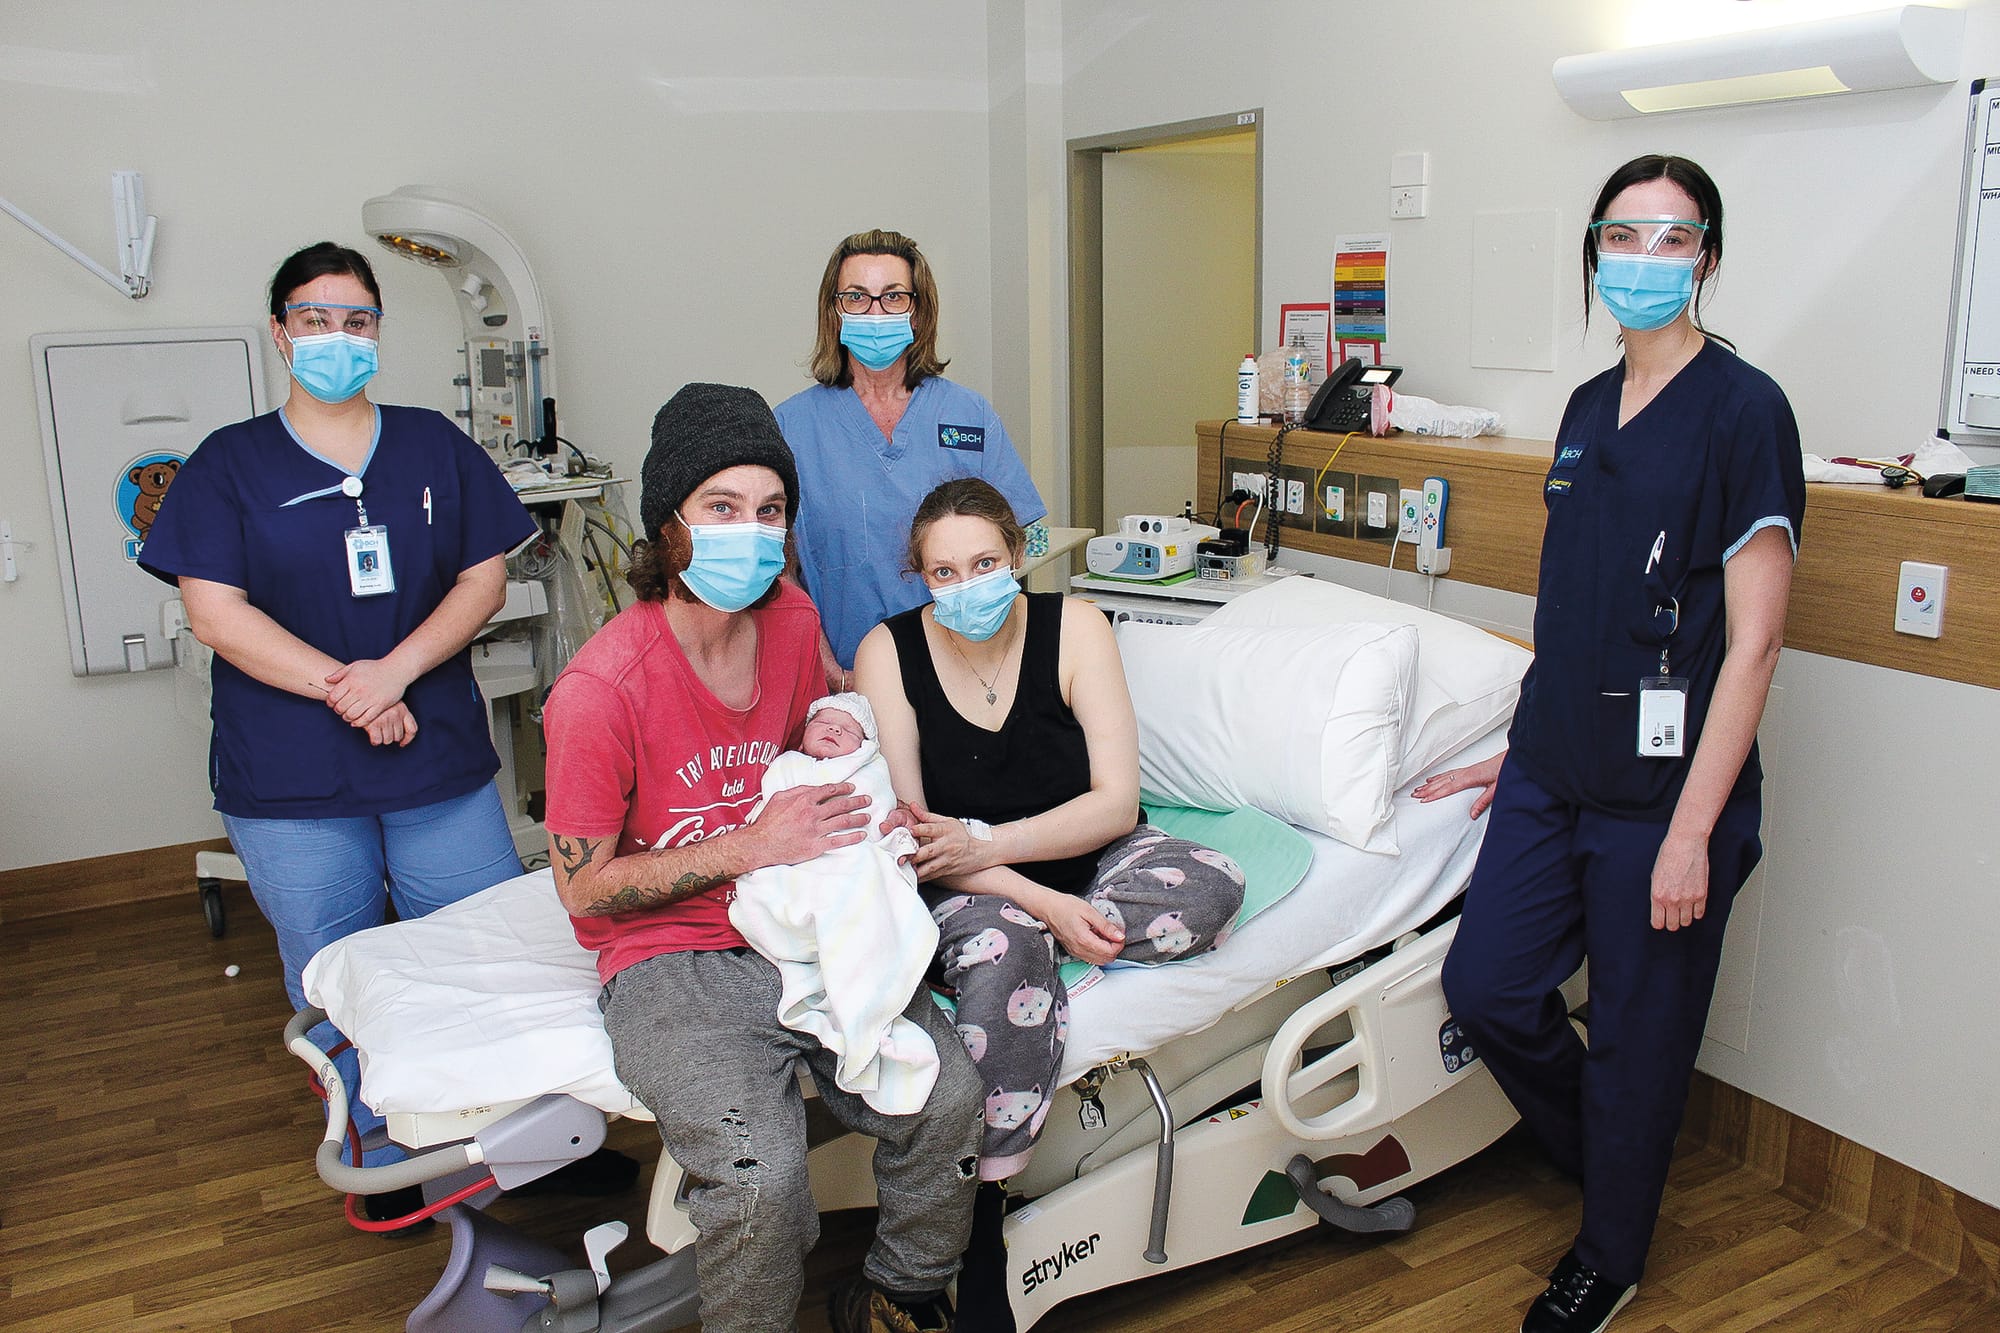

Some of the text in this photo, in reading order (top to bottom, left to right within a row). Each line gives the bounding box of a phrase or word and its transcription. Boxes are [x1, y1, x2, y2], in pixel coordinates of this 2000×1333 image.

[1970, 367, 1994, 376] NEED
[960, 433, 982, 444] BCH
[676, 753, 704, 788] TRY
[1022, 1233, 1101, 1296] stryker
